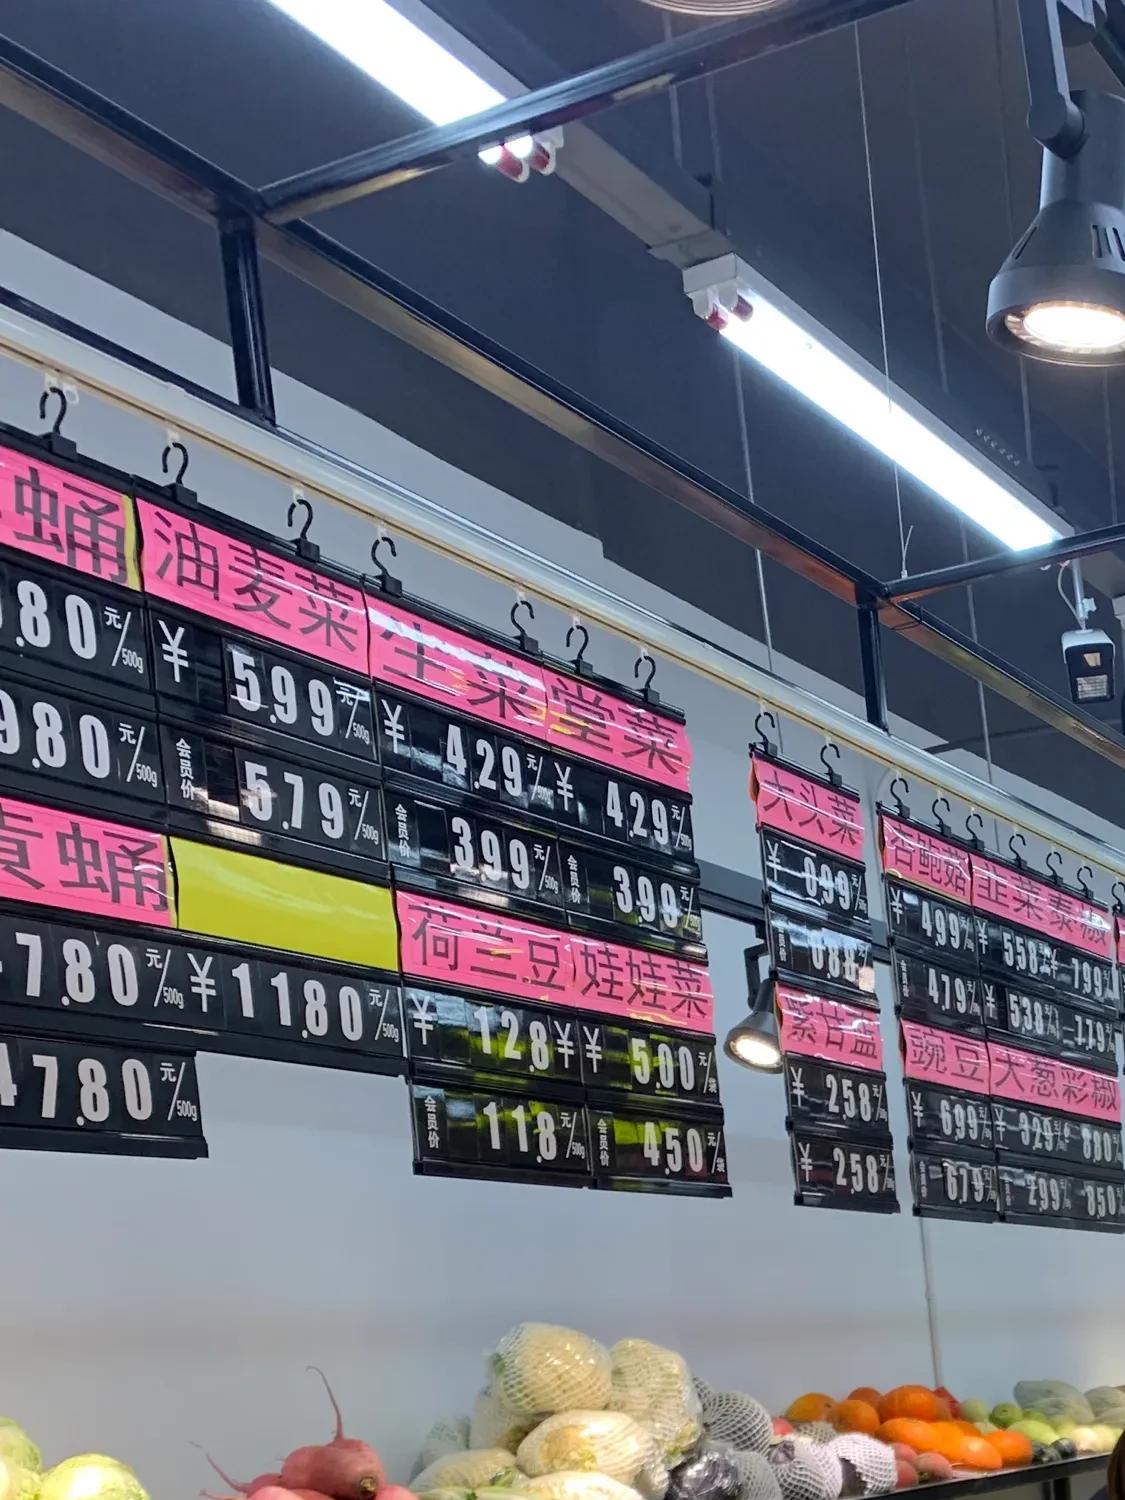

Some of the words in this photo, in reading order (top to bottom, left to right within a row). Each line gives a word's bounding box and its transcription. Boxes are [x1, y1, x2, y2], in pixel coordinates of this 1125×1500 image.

[0, 466, 127, 584] 蛹
[0, 580, 97, 660] .80
[155, 511, 358, 652] 油麦菜
[382, 615, 542, 727] 生菜
[763, 770, 861, 846] 大头菜
[891, 825, 966, 896] 杏鲍菇
[0, 931, 138, 1006] 7.80
[408, 903, 567, 992] 荷兰豆
[580, 942, 708, 1019] 娃娃菜
[910, 1027, 985, 1084] 豌豆
[995, 1049, 1059, 1099] 大葱
